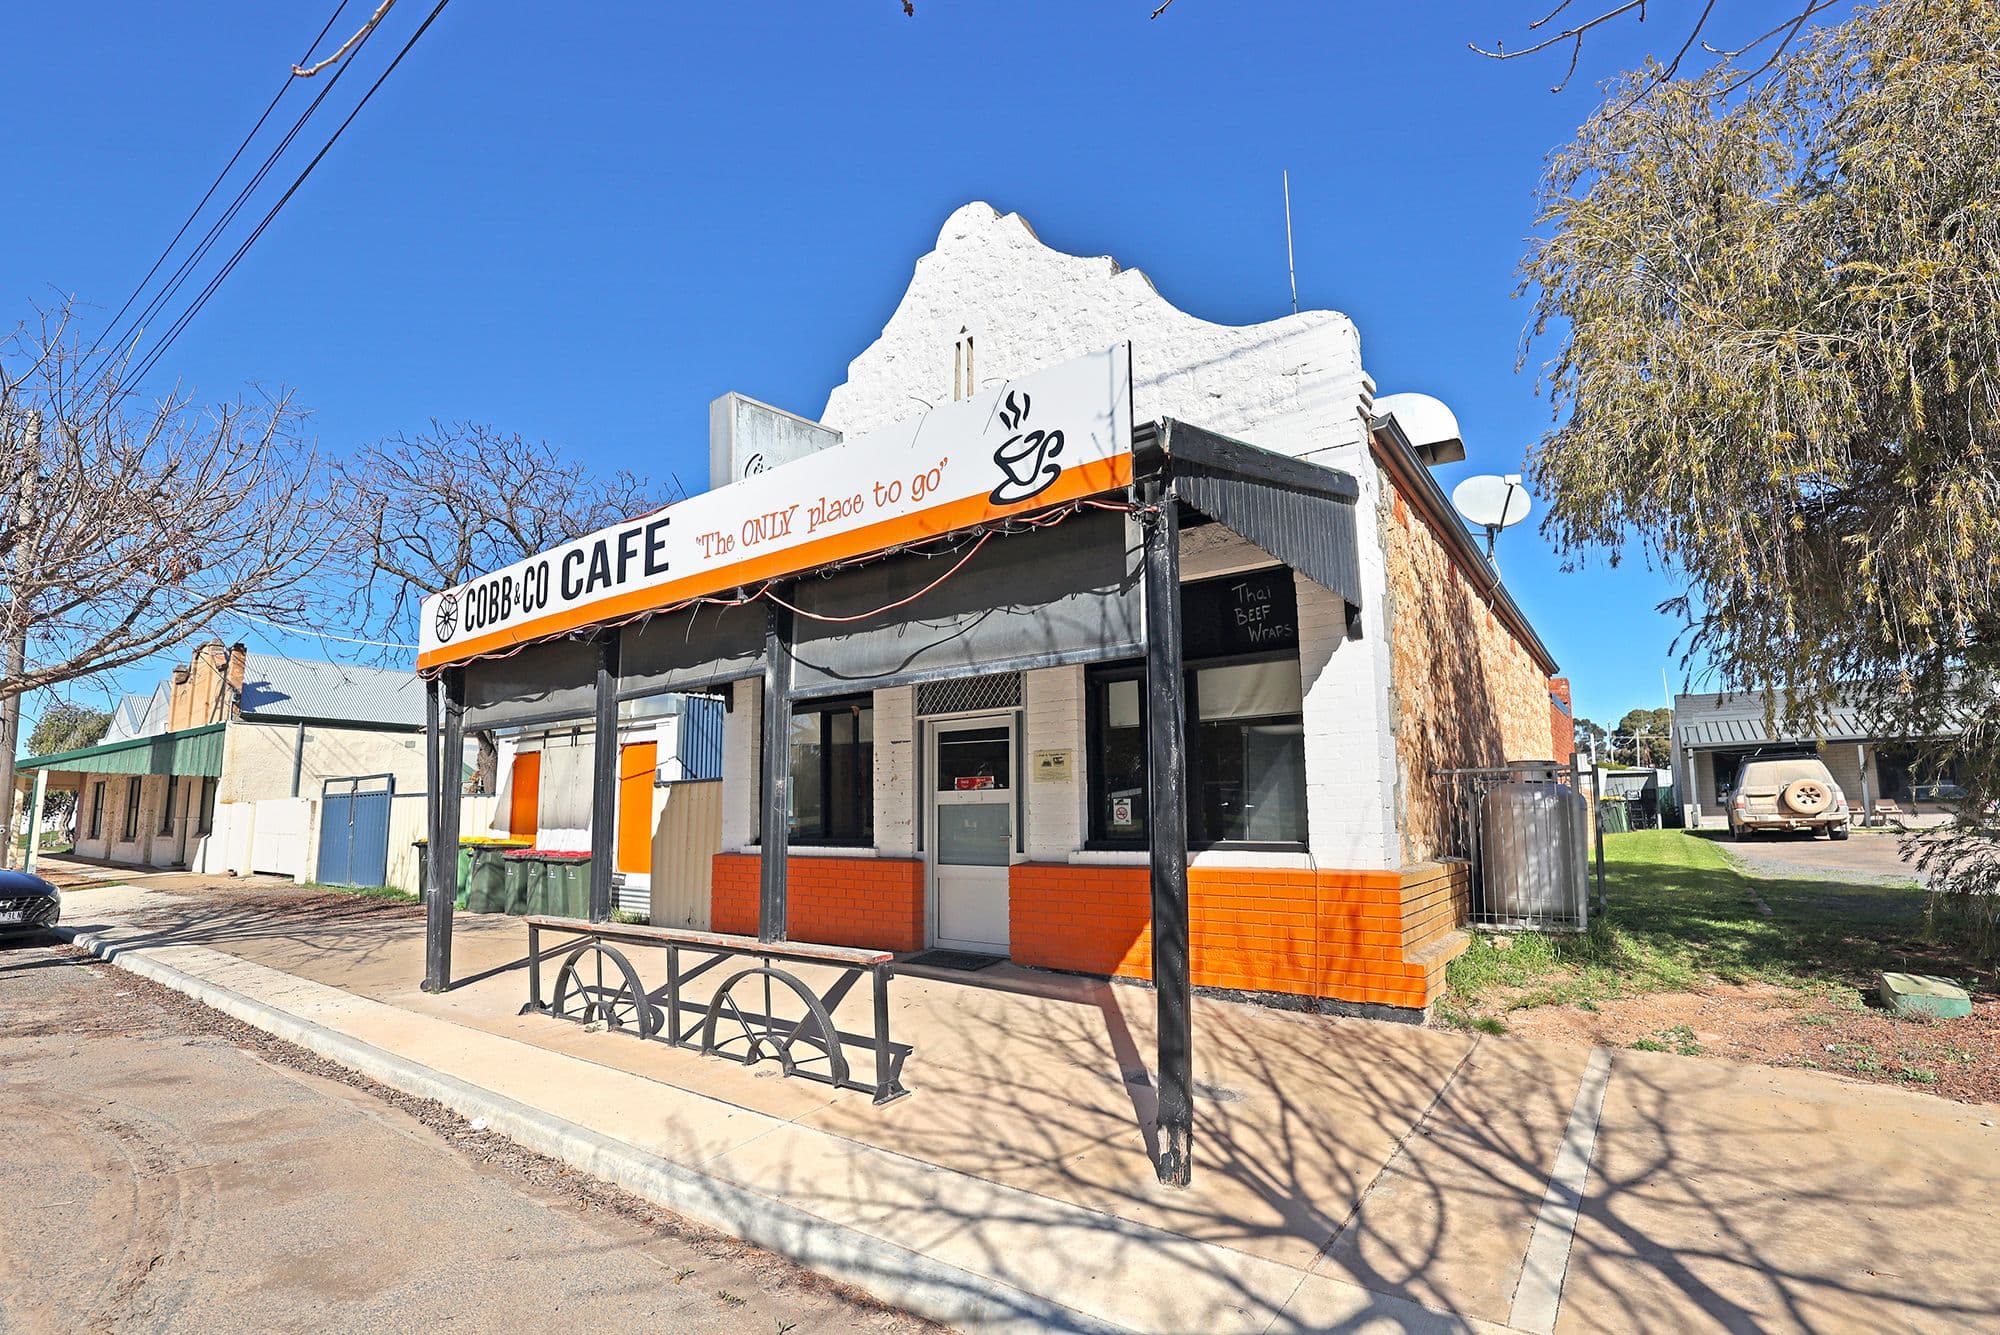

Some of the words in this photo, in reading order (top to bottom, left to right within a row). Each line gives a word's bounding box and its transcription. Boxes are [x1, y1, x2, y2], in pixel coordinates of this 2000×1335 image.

[741, 504, 800, 548] ONLY
[807, 494, 864, 534] place
[873, 480, 902, 508] to
[561, 517, 671, 601] CAFE
[1231, 583, 1272, 603] Thai
[1234, 605, 1271, 626] BEEF
